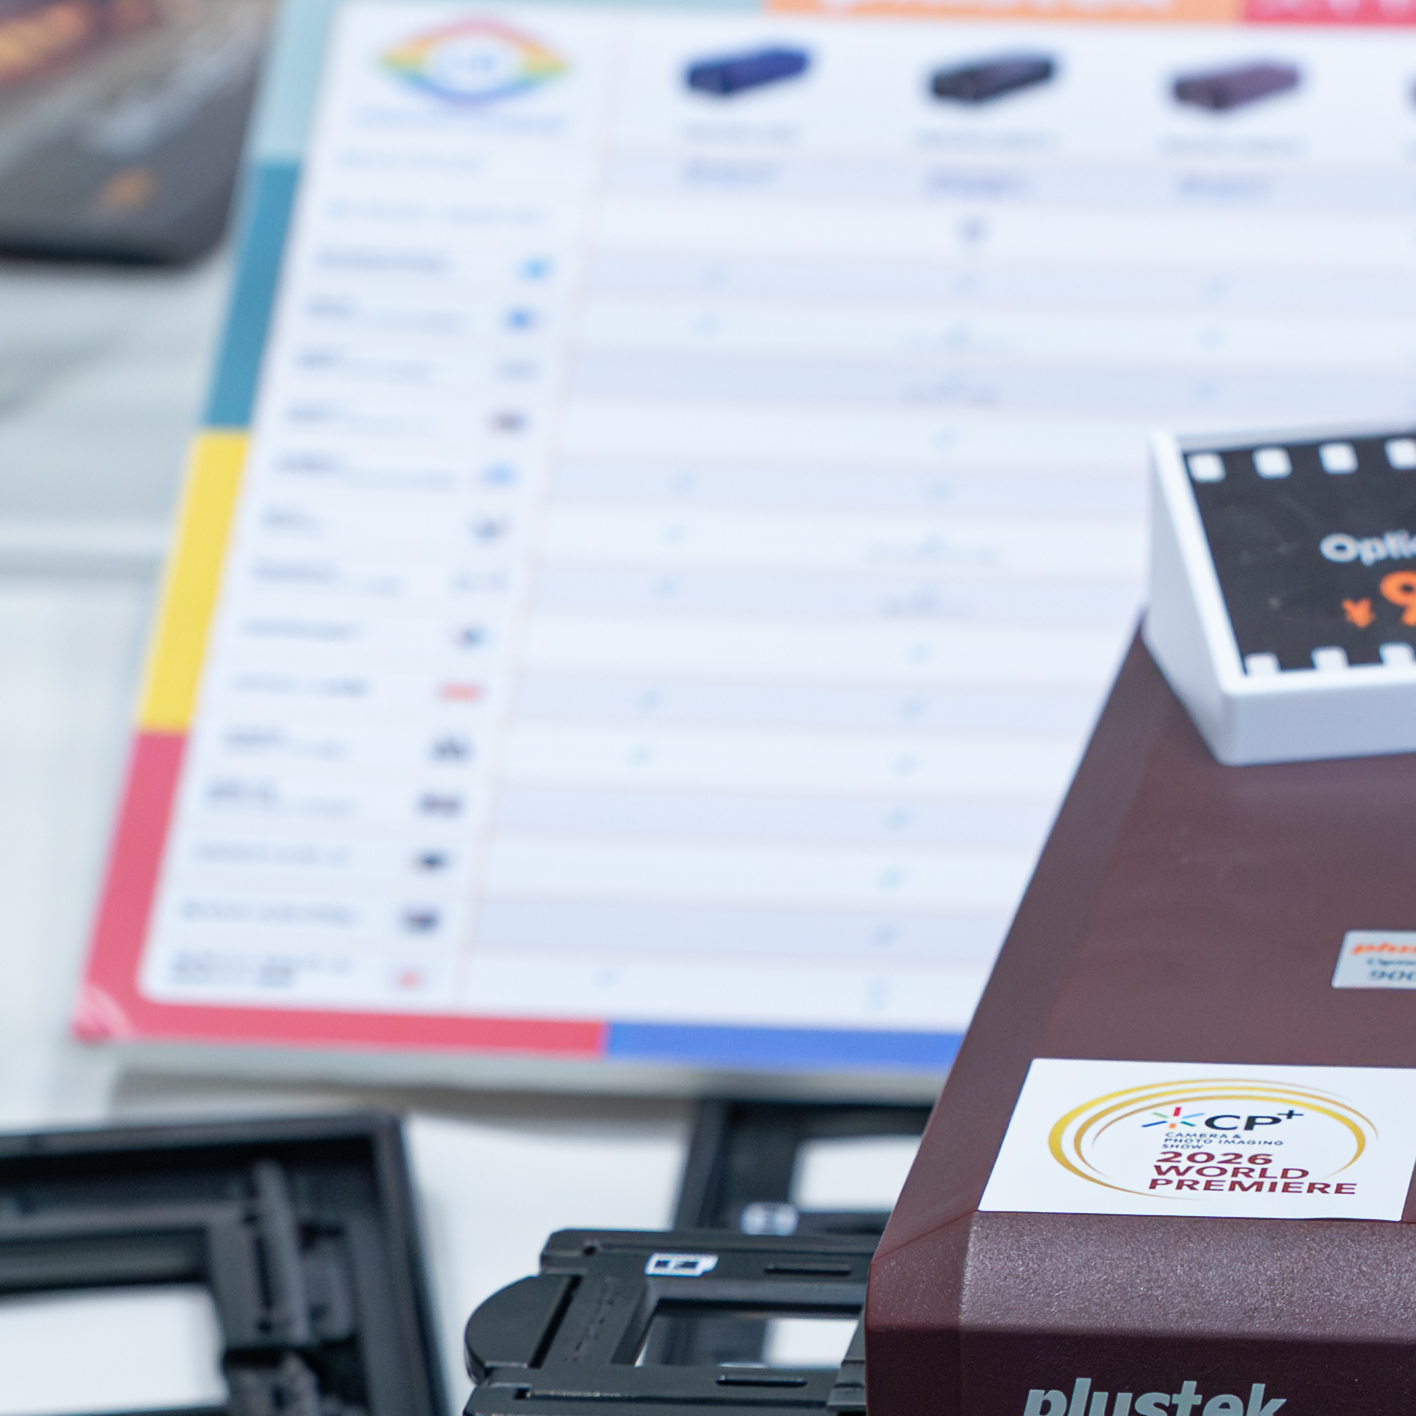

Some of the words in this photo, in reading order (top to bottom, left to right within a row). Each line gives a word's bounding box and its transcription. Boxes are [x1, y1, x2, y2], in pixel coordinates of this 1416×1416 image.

[1204, 1109, 1304, 1132] CP+
[1165, 1131, 1228, 1139] CAMERA
[1155, 1151, 1274, 1166] 2026
[1153, 1164, 1310, 1180] WORLD
[1148, 1178, 1358, 1195] PREMIERE
